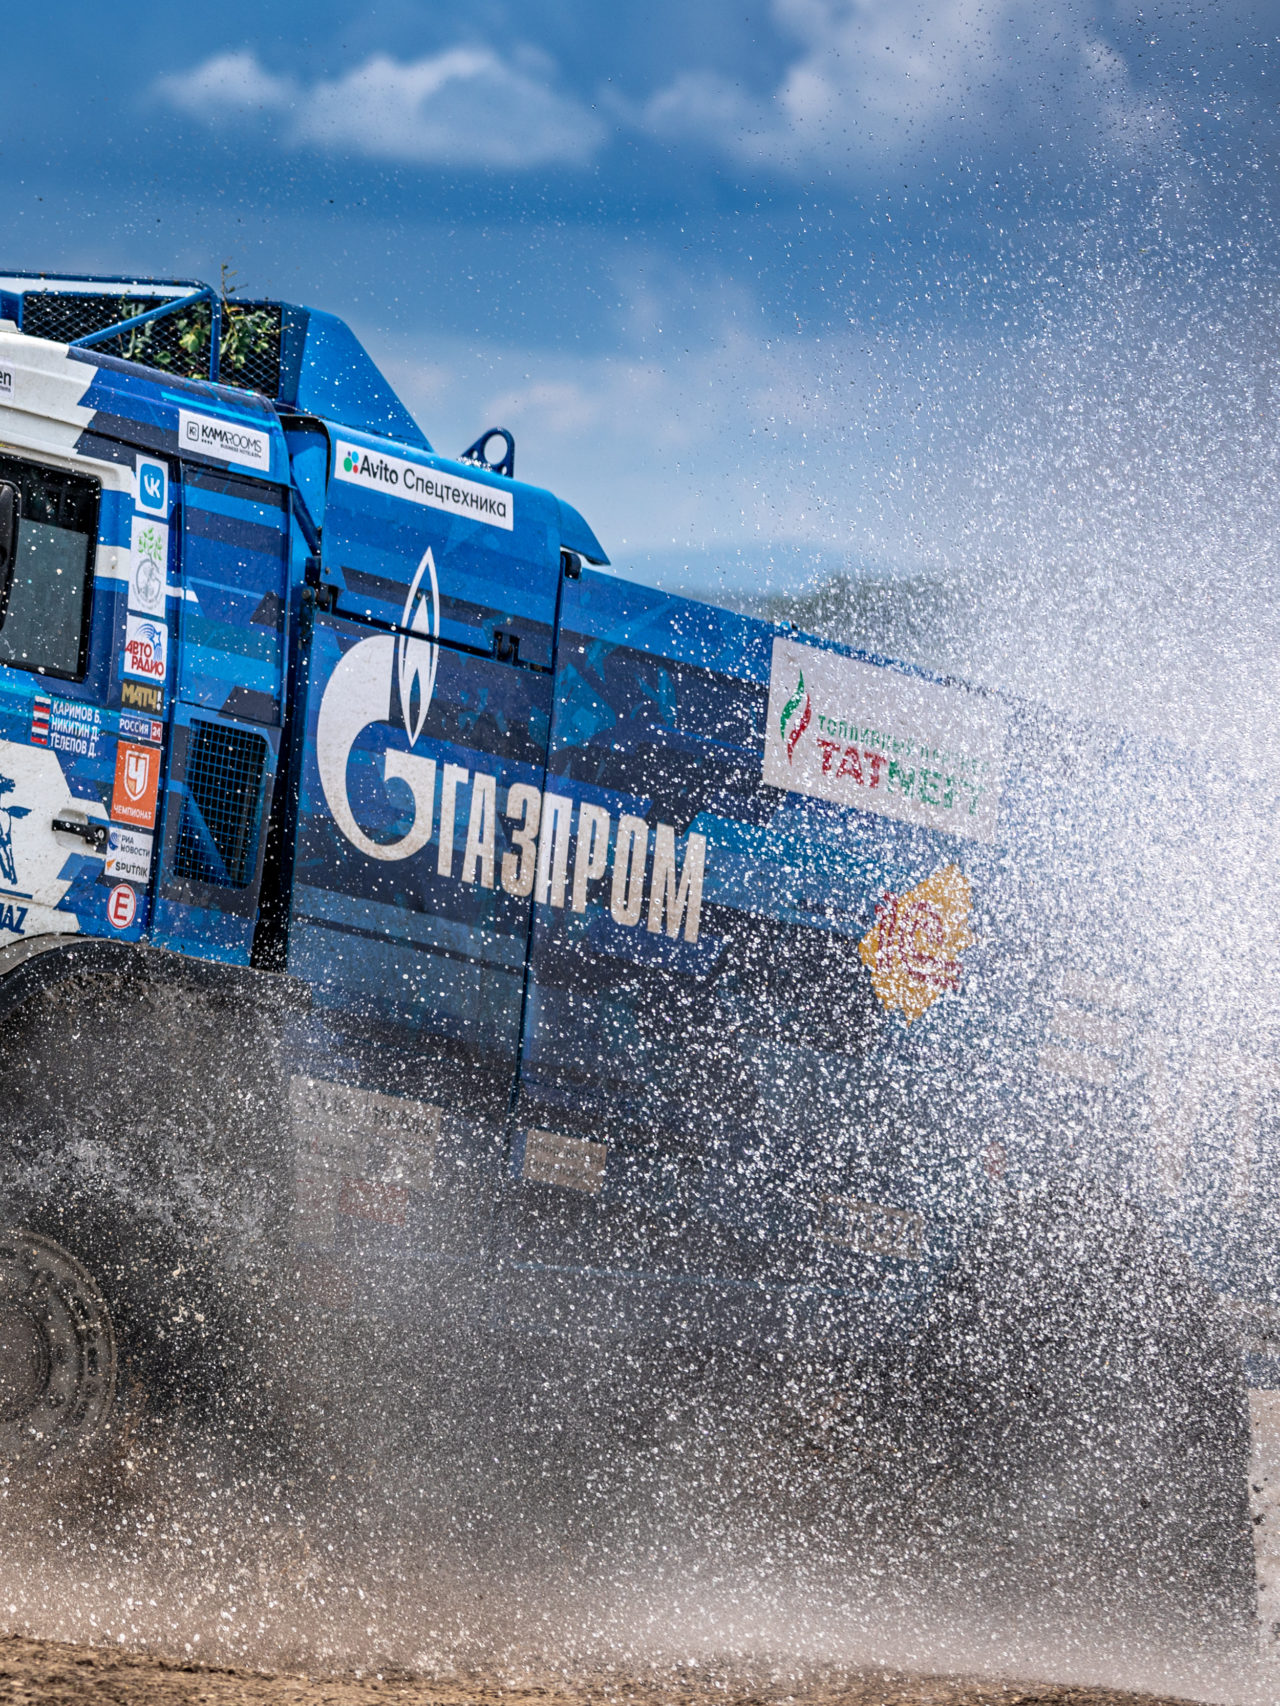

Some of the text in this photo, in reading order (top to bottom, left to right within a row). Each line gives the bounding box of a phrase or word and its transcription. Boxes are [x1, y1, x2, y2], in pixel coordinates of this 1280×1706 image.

[201, 424, 262, 453] KAMAROOMS
[360, 455, 507, 519] Avito Спецтехника
[124, 639, 153, 657] АВТО
[131, 654, 165, 678] РАДИО
[121, 682, 163, 711] МАТЧ!
[52, 700, 93, 723] КАРИМОВ
[51, 714, 91, 736] НИКИТИН
[119, 718, 162, 739] РОССИЯ 24
[50, 732, 87, 755] ТЕЛЕПОВ
[113, 803, 153, 821] ЧЕМПИОНАТ
[120, 834, 135, 845] РИА
[120, 842, 151, 858] НОВОСТИ
[436, 762, 708, 945] ГАЗПРОМ
[113, 892, 131, 921] E
